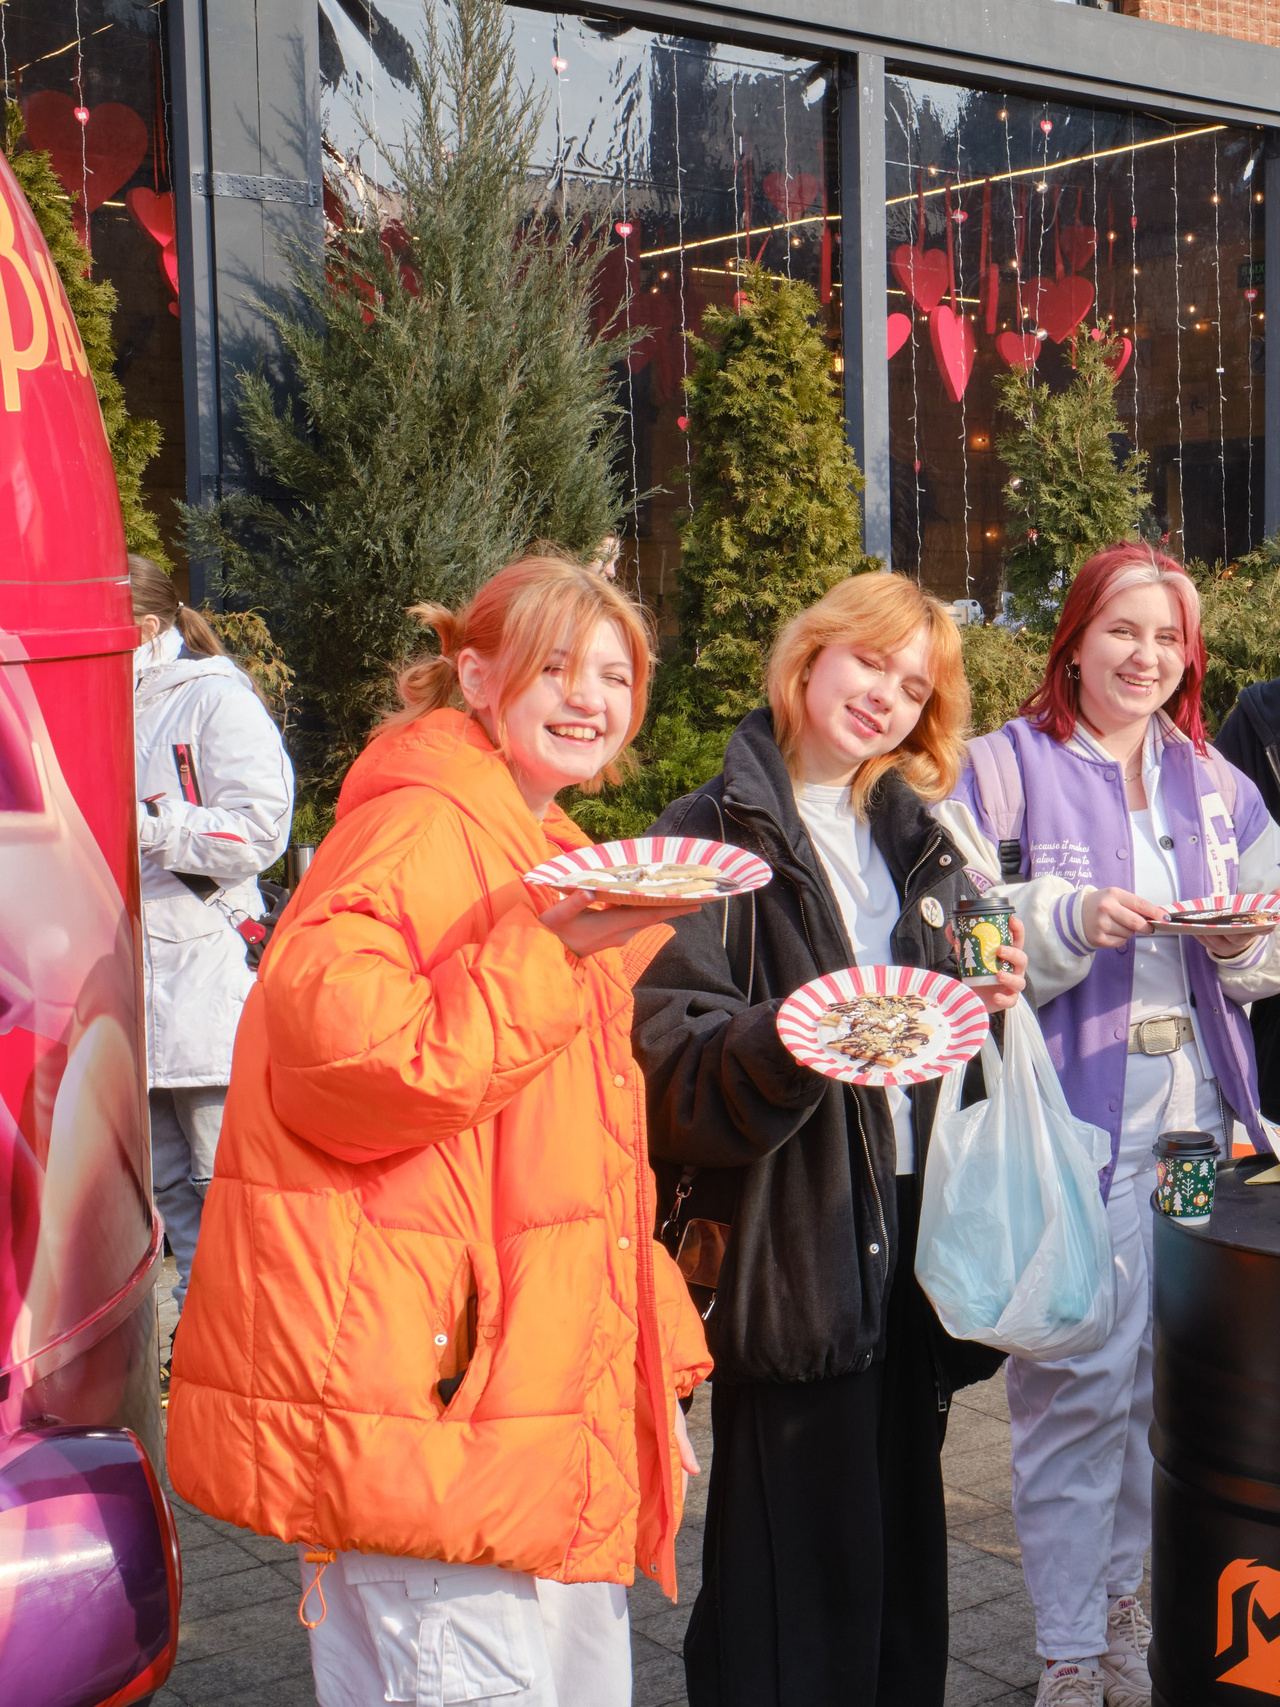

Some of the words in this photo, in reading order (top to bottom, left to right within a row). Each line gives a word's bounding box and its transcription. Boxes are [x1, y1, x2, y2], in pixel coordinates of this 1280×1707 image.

[1061, 838, 1069, 850] it
[1069, 842, 1090, 853] makes
[1059, 852, 1070, 867] I
[1082, 854, 1090, 865] to
[1064, 870, 1077, 880] my
[1077, 866, 1092, 878] hair
